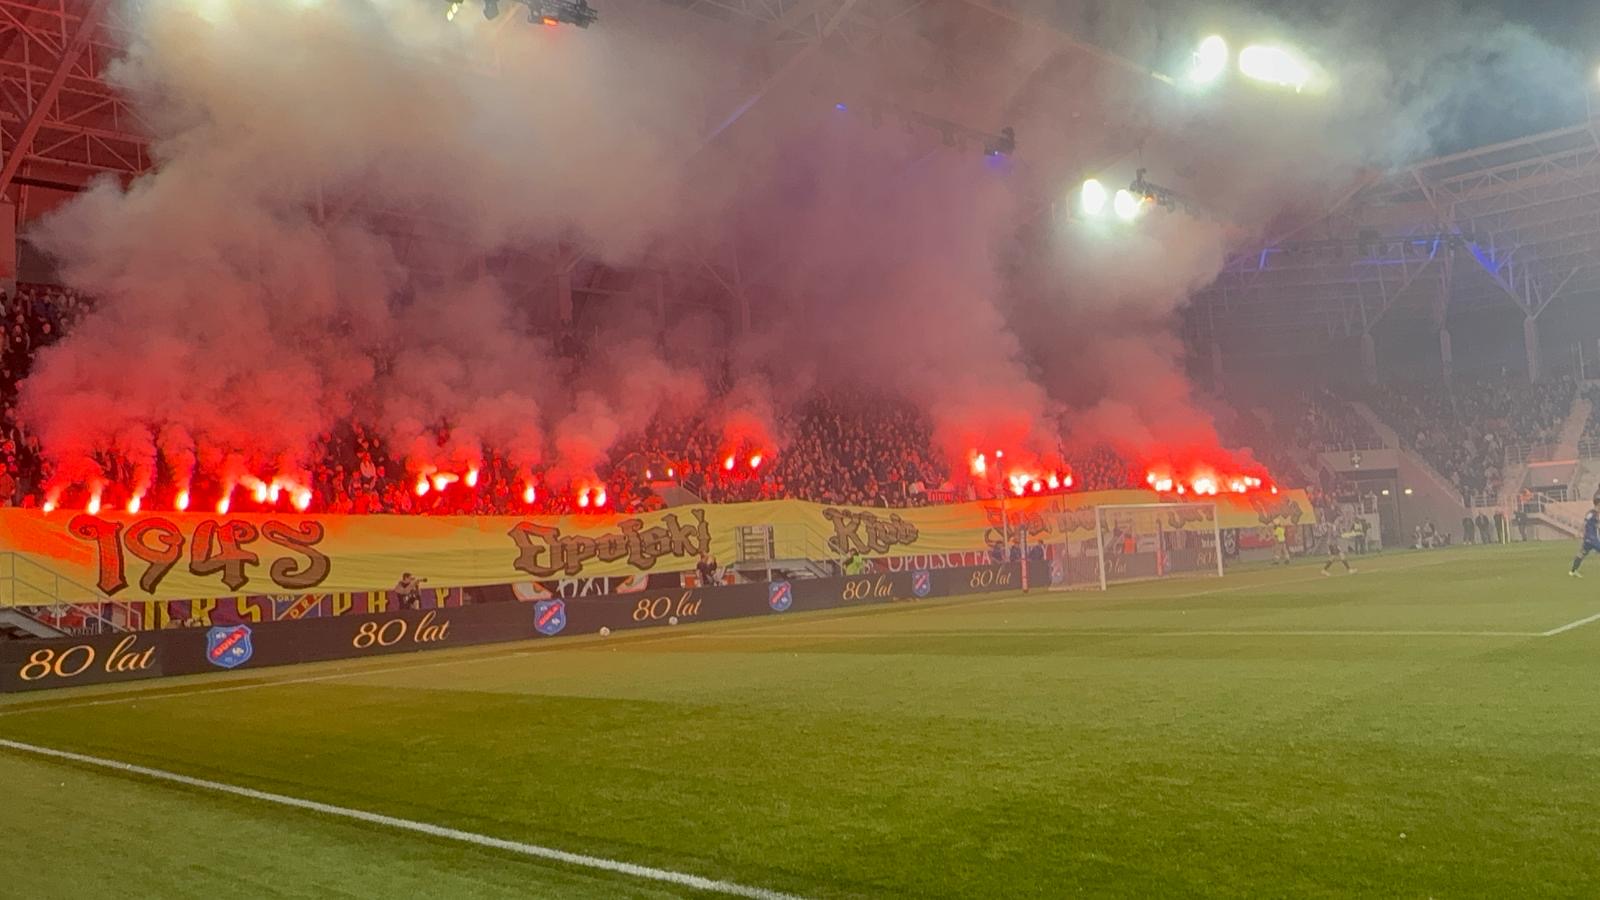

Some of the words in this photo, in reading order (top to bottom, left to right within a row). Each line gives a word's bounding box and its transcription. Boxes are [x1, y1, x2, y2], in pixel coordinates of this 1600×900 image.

[69, 514, 330, 596] 1945
[842, 580, 870, 601] 80
[874, 574, 893, 597] lat
[970, 570, 993, 588] 80
[996, 566, 1011, 585] lat
[633, 598, 671, 621] 80
[676, 591, 702, 617] lat
[352, 618, 407, 649] 80
[414, 610, 449, 643] lat
[19, 644, 95, 681] 80
[105, 634, 156, 673] lat
